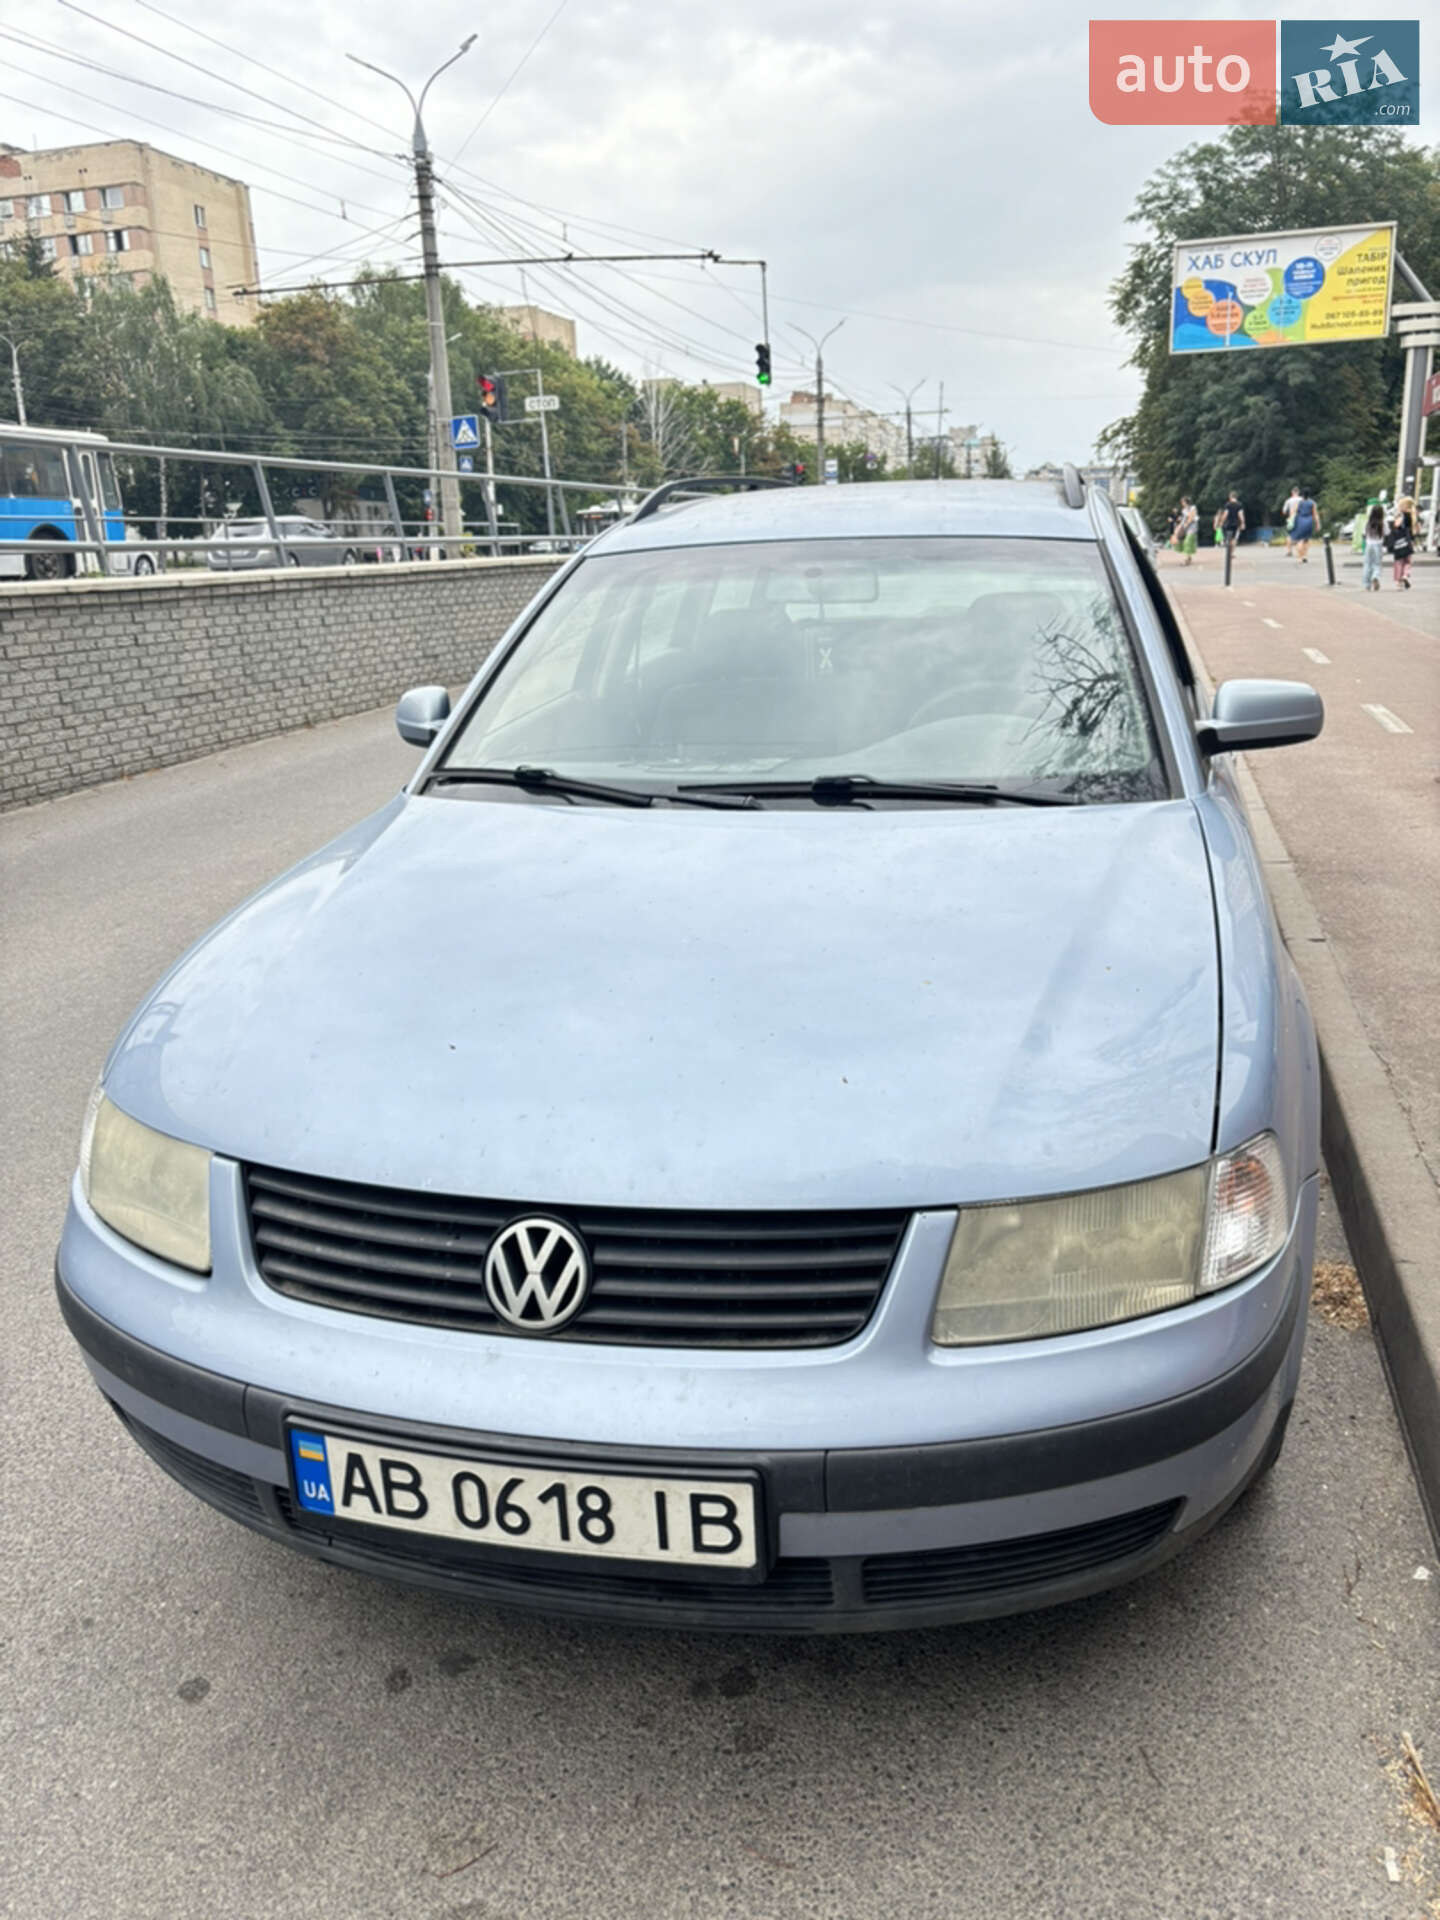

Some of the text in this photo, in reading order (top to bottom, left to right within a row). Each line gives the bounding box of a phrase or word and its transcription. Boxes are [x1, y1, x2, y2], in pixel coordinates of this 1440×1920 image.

[1187, 253, 1225, 271] ХАБ
[1356, 252, 1388, 262] ТАБІР
[303, 1480, 331, 1502] UA
[341, 1451, 743, 1555] AB 0618 IB
